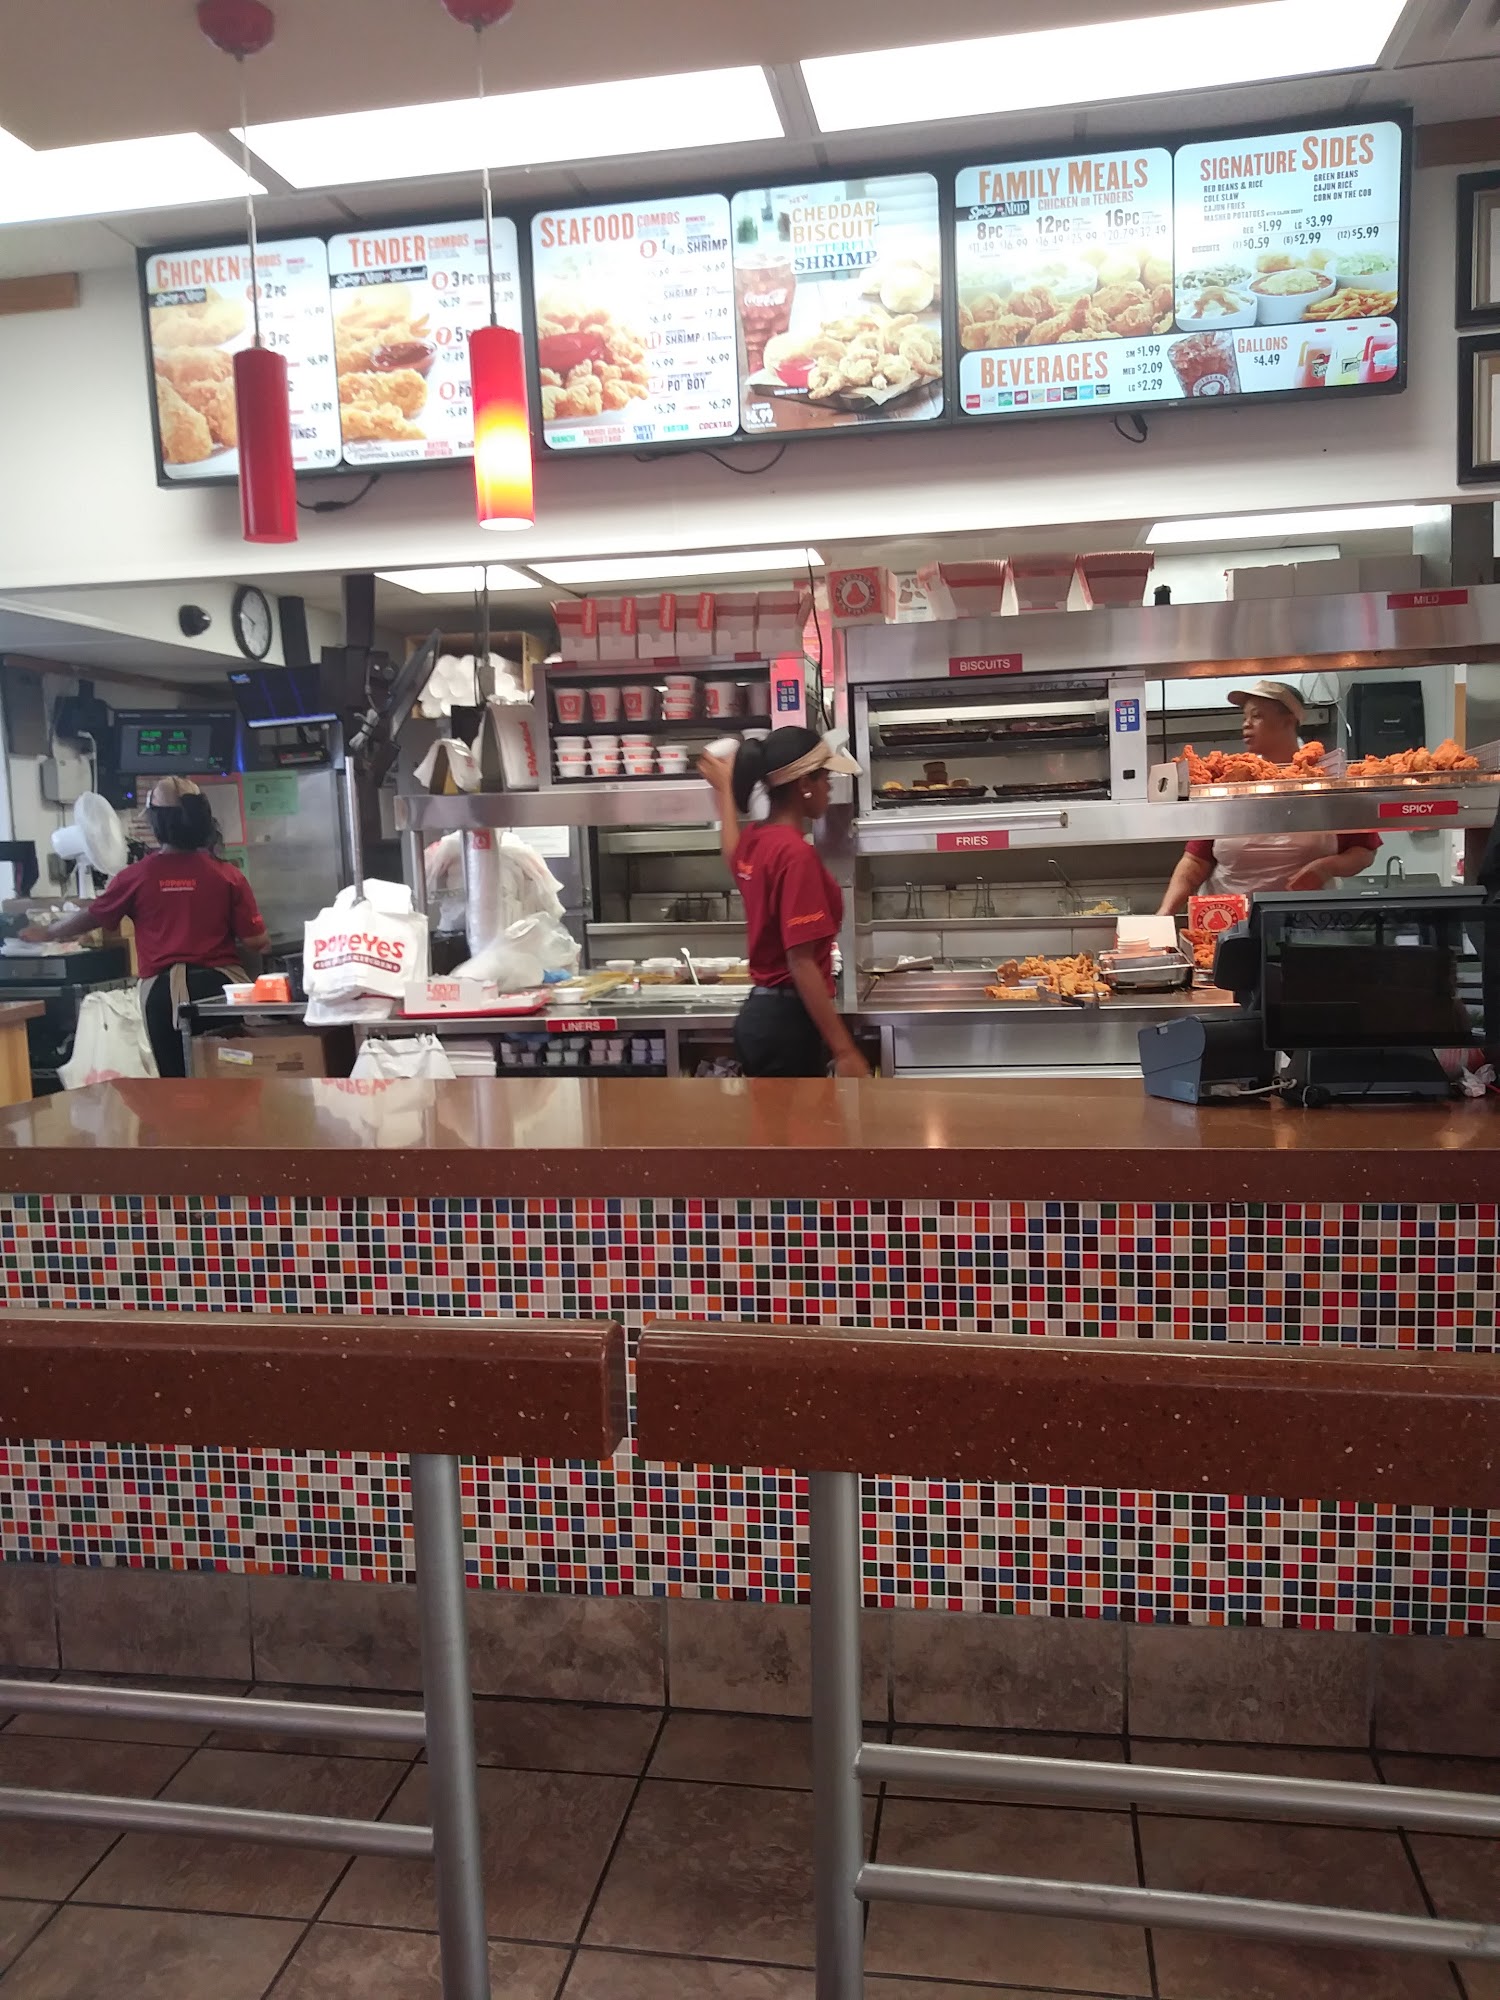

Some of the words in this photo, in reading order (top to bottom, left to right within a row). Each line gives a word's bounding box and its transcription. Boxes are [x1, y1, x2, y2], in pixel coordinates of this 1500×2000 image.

[1200, 149, 1298, 182] SIGNATURE
[1302, 133, 1375, 171] SIDES
[979, 166, 1061, 204] FAMILY
[1067, 158, 1149, 195] MEALS
[1313, 172, 1335, 182] GREEN
[1336, 169, 1359, 180] BEANS
[1203, 185, 1216, 193] RED
[1217, 183, 1239, 192] BEANS
[1248, 179, 1263, 189] RICE
[1313, 183, 1336, 192] CAJUN
[1337, 180, 1353, 190] RICE
[1037, 196, 1078, 211] CHICKEN
[1092, 191, 1134, 206] TENDERS
[1203, 194, 1220, 203] COLE
[1221, 192, 1239, 201] SLAW
[1313, 192, 1332, 202] CORN
[1333, 191, 1343, 200] ON
[1344, 190, 1357, 199] THE
[1358, 188, 1372, 198] COB
[792, 200, 876, 224] CHEDDAR
[968, 205, 997, 220] Spicy
[1203, 204, 1225, 213] CAJUN
[1227, 202, 1246, 211] FRIES
[1233, 209, 1265, 219] POTATOES
[540, 212, 635, 249] SEAFOOD
[637, 211, 681, 228] COMBOS
[1258, 219, 1282, 232] $1.99
[1305, 214, 1333, 228] $3.99
[793, 218, 876, 244] BISCUIT
[1243, 236, 1270, 250] $0.59
[1294, 231, 1321, 245] $2.99
[1337, 230, 1351, 241] (12)
[1352, 225, 1380, 240] $5.99
[348, 234, 427, 268] TENDER
[687, 238, 728, 254] SHRIMP
[794, 250, 878, 271] SHRIMP
[155, 255, 241, 290] CHICKEN
[664, 287, 698, 300] SHRIMP
[665, 332, 701, 346] SHRIMP
[1237, 336, 1288, 354] GALLONS
[1125, 349, 1136, 359] SM
[1137, 344, 1161, 357] $1.99
[1253, 353, 1280, 367] $4.49
[980, 350, 1109, 389] BEVERAGES
[1122, 366, 1136, 376] MED
[1137, 361, 1163, 375] $2.09
[687, 378, 707, 391] BOY
[1137, 378, 1163, 392] $2.29
[698, 420, 733, 431] COCKTAIL
[1413, 594, 1440, 605] MILD
[959, 658, 1011, 672] BISCUITS
[1401, 804, 1435, 814] SPICY
[956, 836, 989, 847] FRIES
[561, 1021, 601, 1032] LINERS
